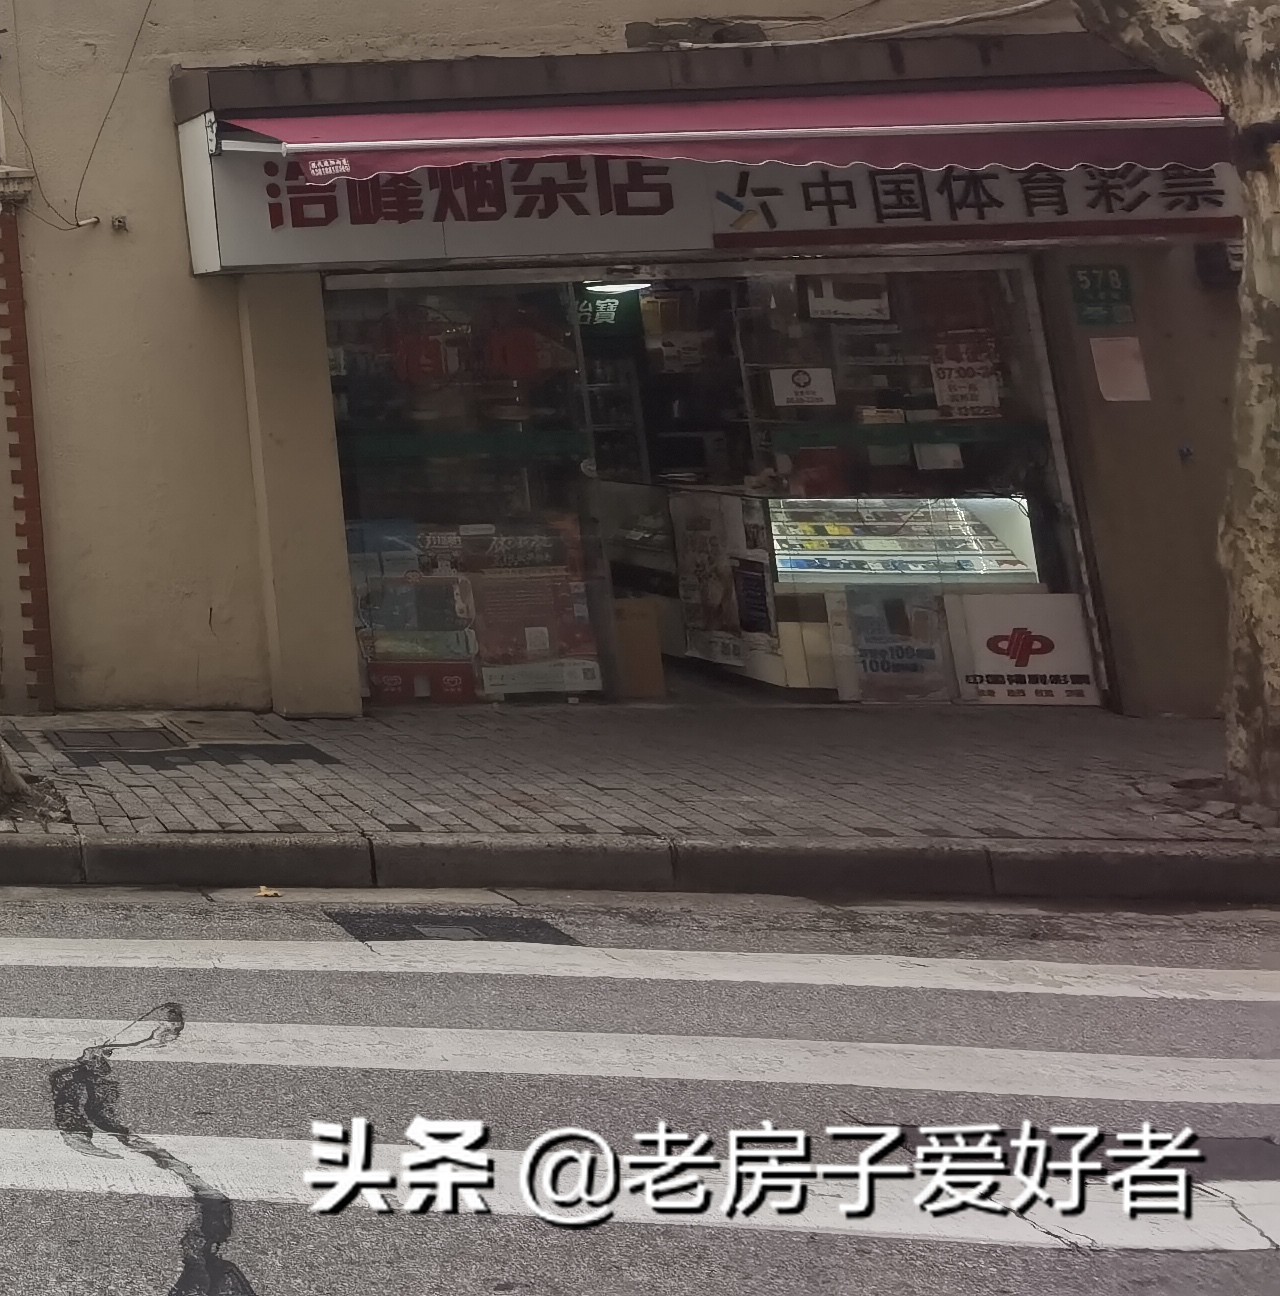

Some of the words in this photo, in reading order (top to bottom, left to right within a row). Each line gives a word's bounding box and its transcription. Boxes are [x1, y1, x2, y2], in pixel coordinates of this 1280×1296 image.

[801, 164, 1226, 227] 中国体育彩票
[1077, 269, 1121, 289] 578
